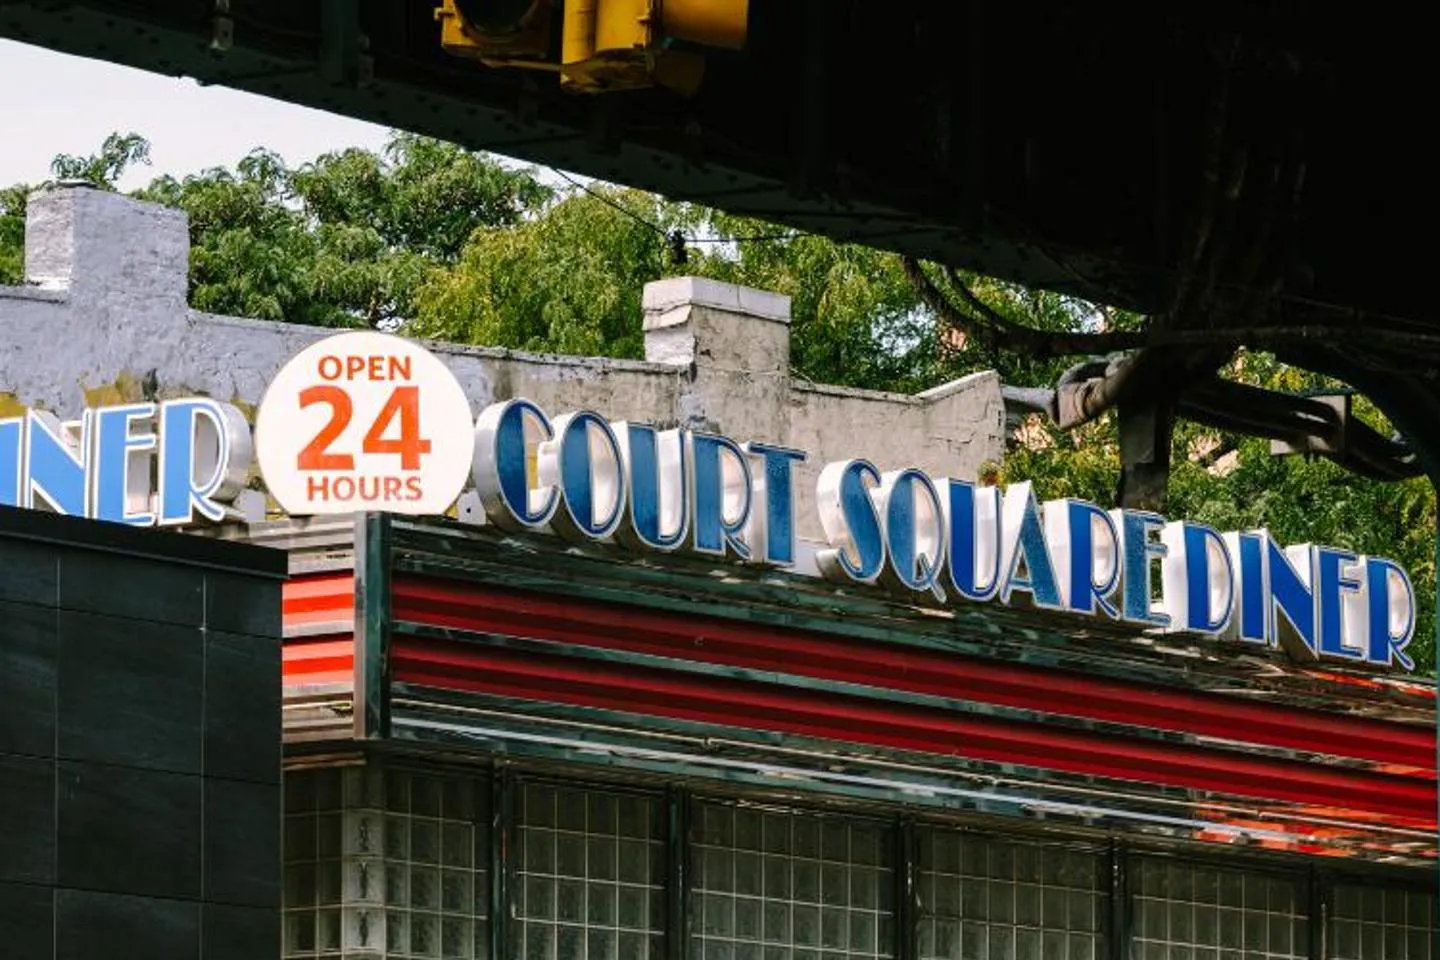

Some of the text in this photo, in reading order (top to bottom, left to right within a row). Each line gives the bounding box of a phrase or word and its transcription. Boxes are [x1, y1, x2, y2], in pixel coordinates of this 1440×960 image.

[318, 355, 411, 381] OPEN
[298, 385, 432, 471] 24
[307, 476, 423, 501] HOURS
[490, 397, 1415, 671] COURT SQUARE DINER
